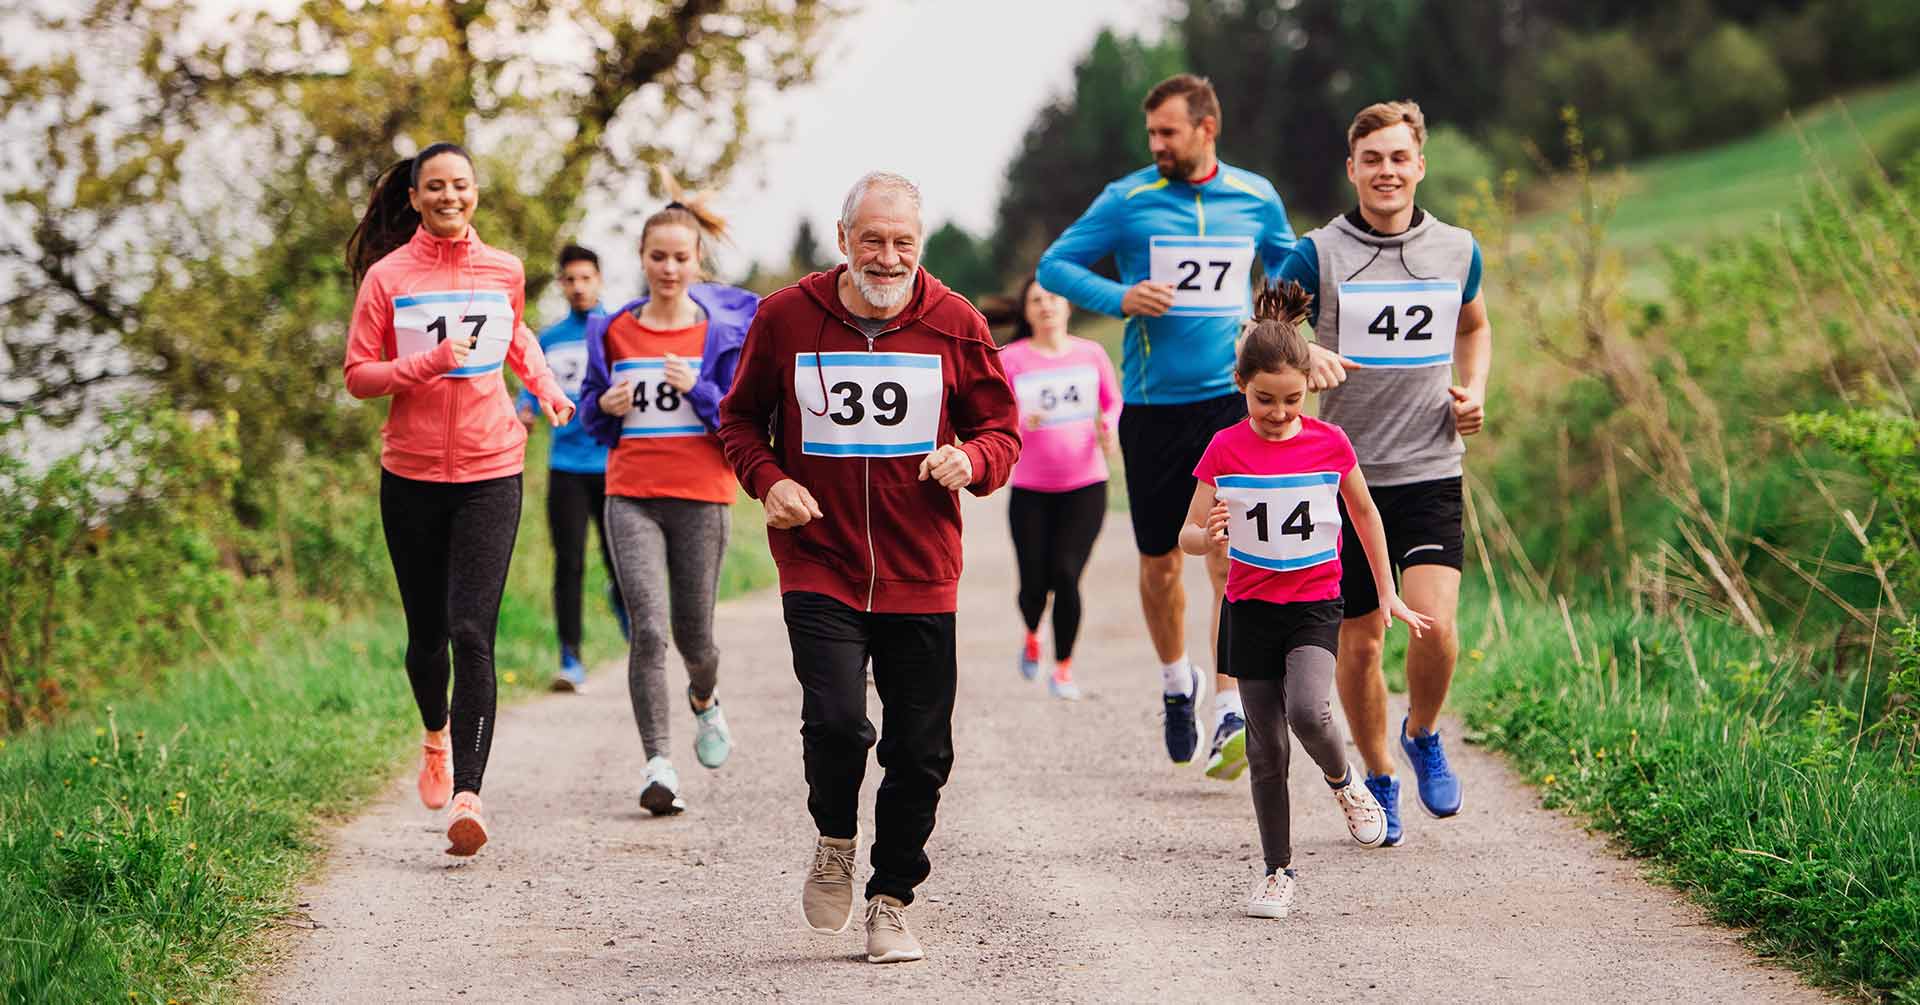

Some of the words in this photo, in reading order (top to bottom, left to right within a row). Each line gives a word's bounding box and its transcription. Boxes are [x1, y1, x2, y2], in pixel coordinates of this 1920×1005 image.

[1177, 260, 1231, 291] 27
[427, 315, 487, 350] 17
[1368, 305, 1433, 341] 42
[632, 381, 680, 413] 48
[829, 381, 908, 427] 39
[1040, 384, 1080, 411] 54
[1246, 501, 1315, 542] 14
